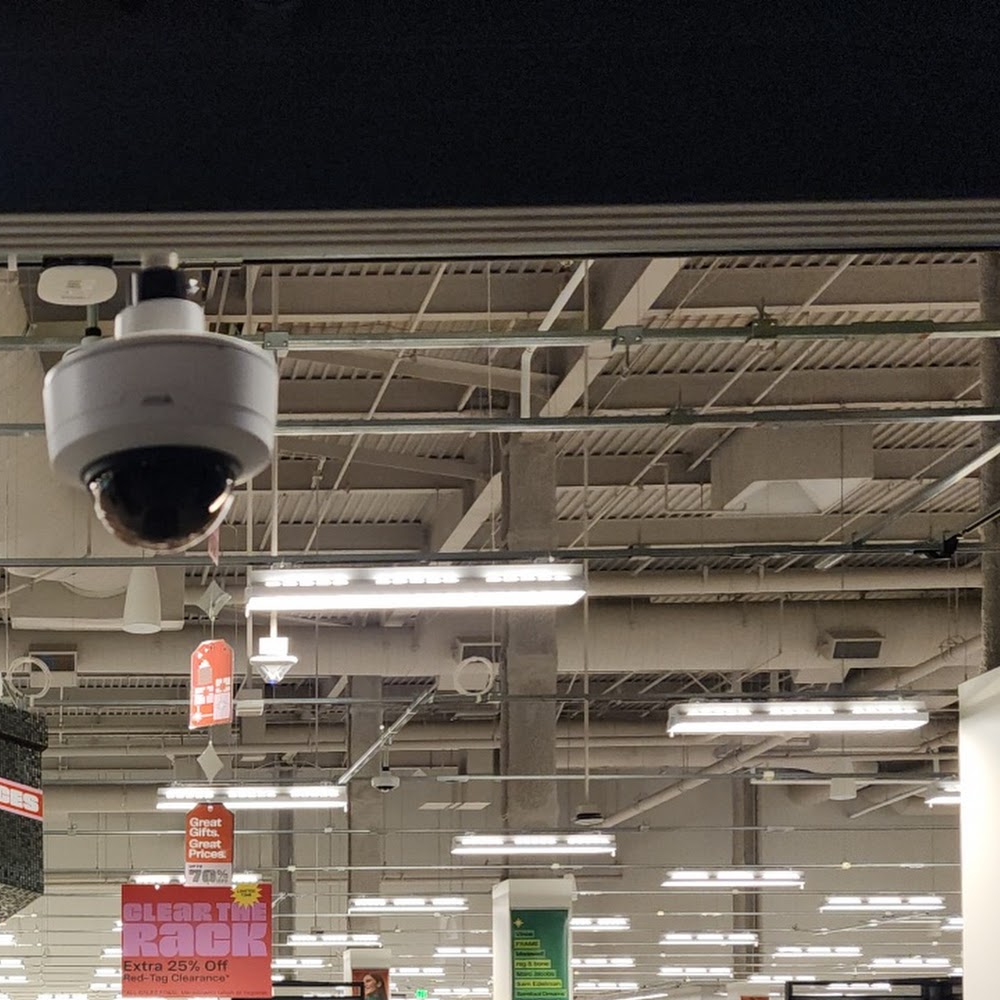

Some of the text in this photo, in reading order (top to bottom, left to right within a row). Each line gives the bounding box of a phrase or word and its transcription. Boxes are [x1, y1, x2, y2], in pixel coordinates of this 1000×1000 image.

[190, 818, 222, 827] Great
[189, 828, 219, 837] Gifts.
[189, 839, 221, 848] Great
[216, 902, 267, 922] THE
[123, 960, 228, 971] Extra 25% Off
